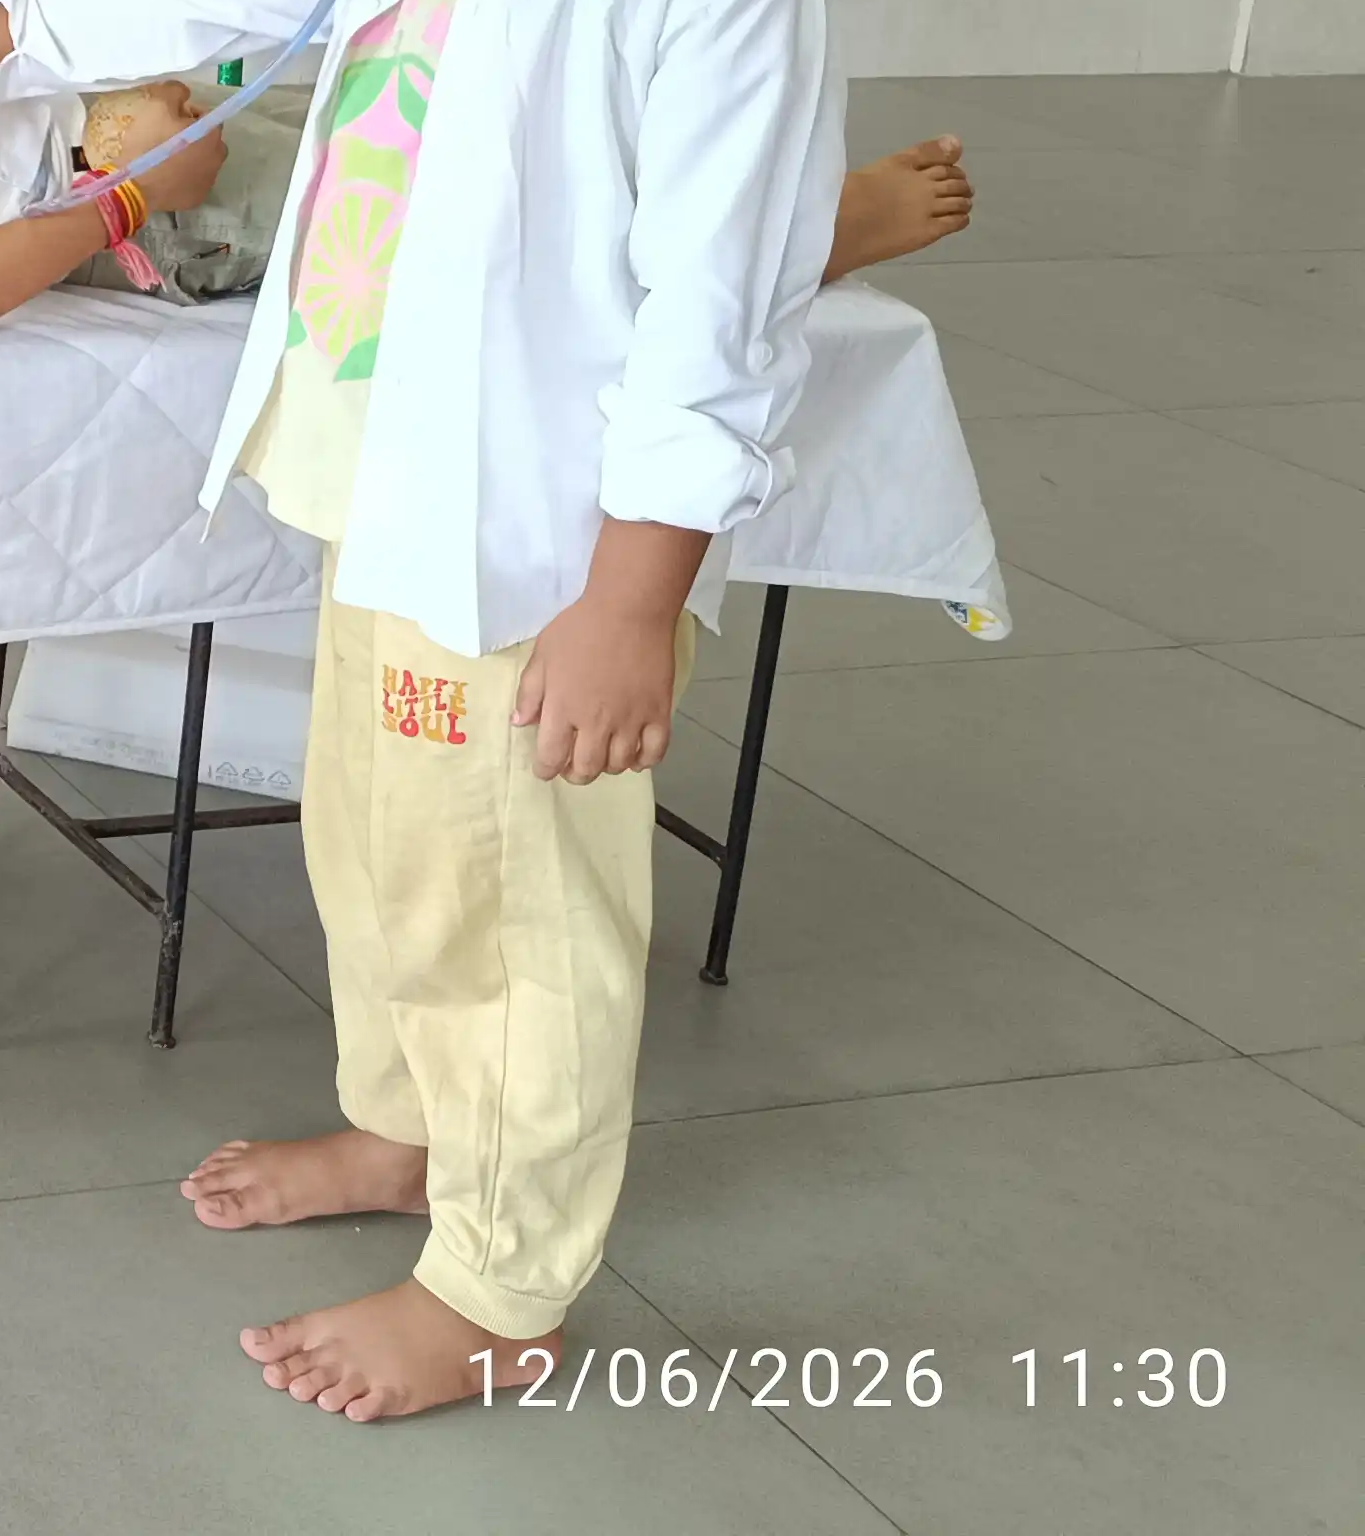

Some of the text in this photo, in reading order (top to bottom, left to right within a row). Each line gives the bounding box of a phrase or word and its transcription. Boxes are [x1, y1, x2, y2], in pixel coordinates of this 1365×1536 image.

[382, 664, 468, 696] HAPPY
[382, 688, 467, 717] LITTLE
[382, 712, 466, 745] SOUL
